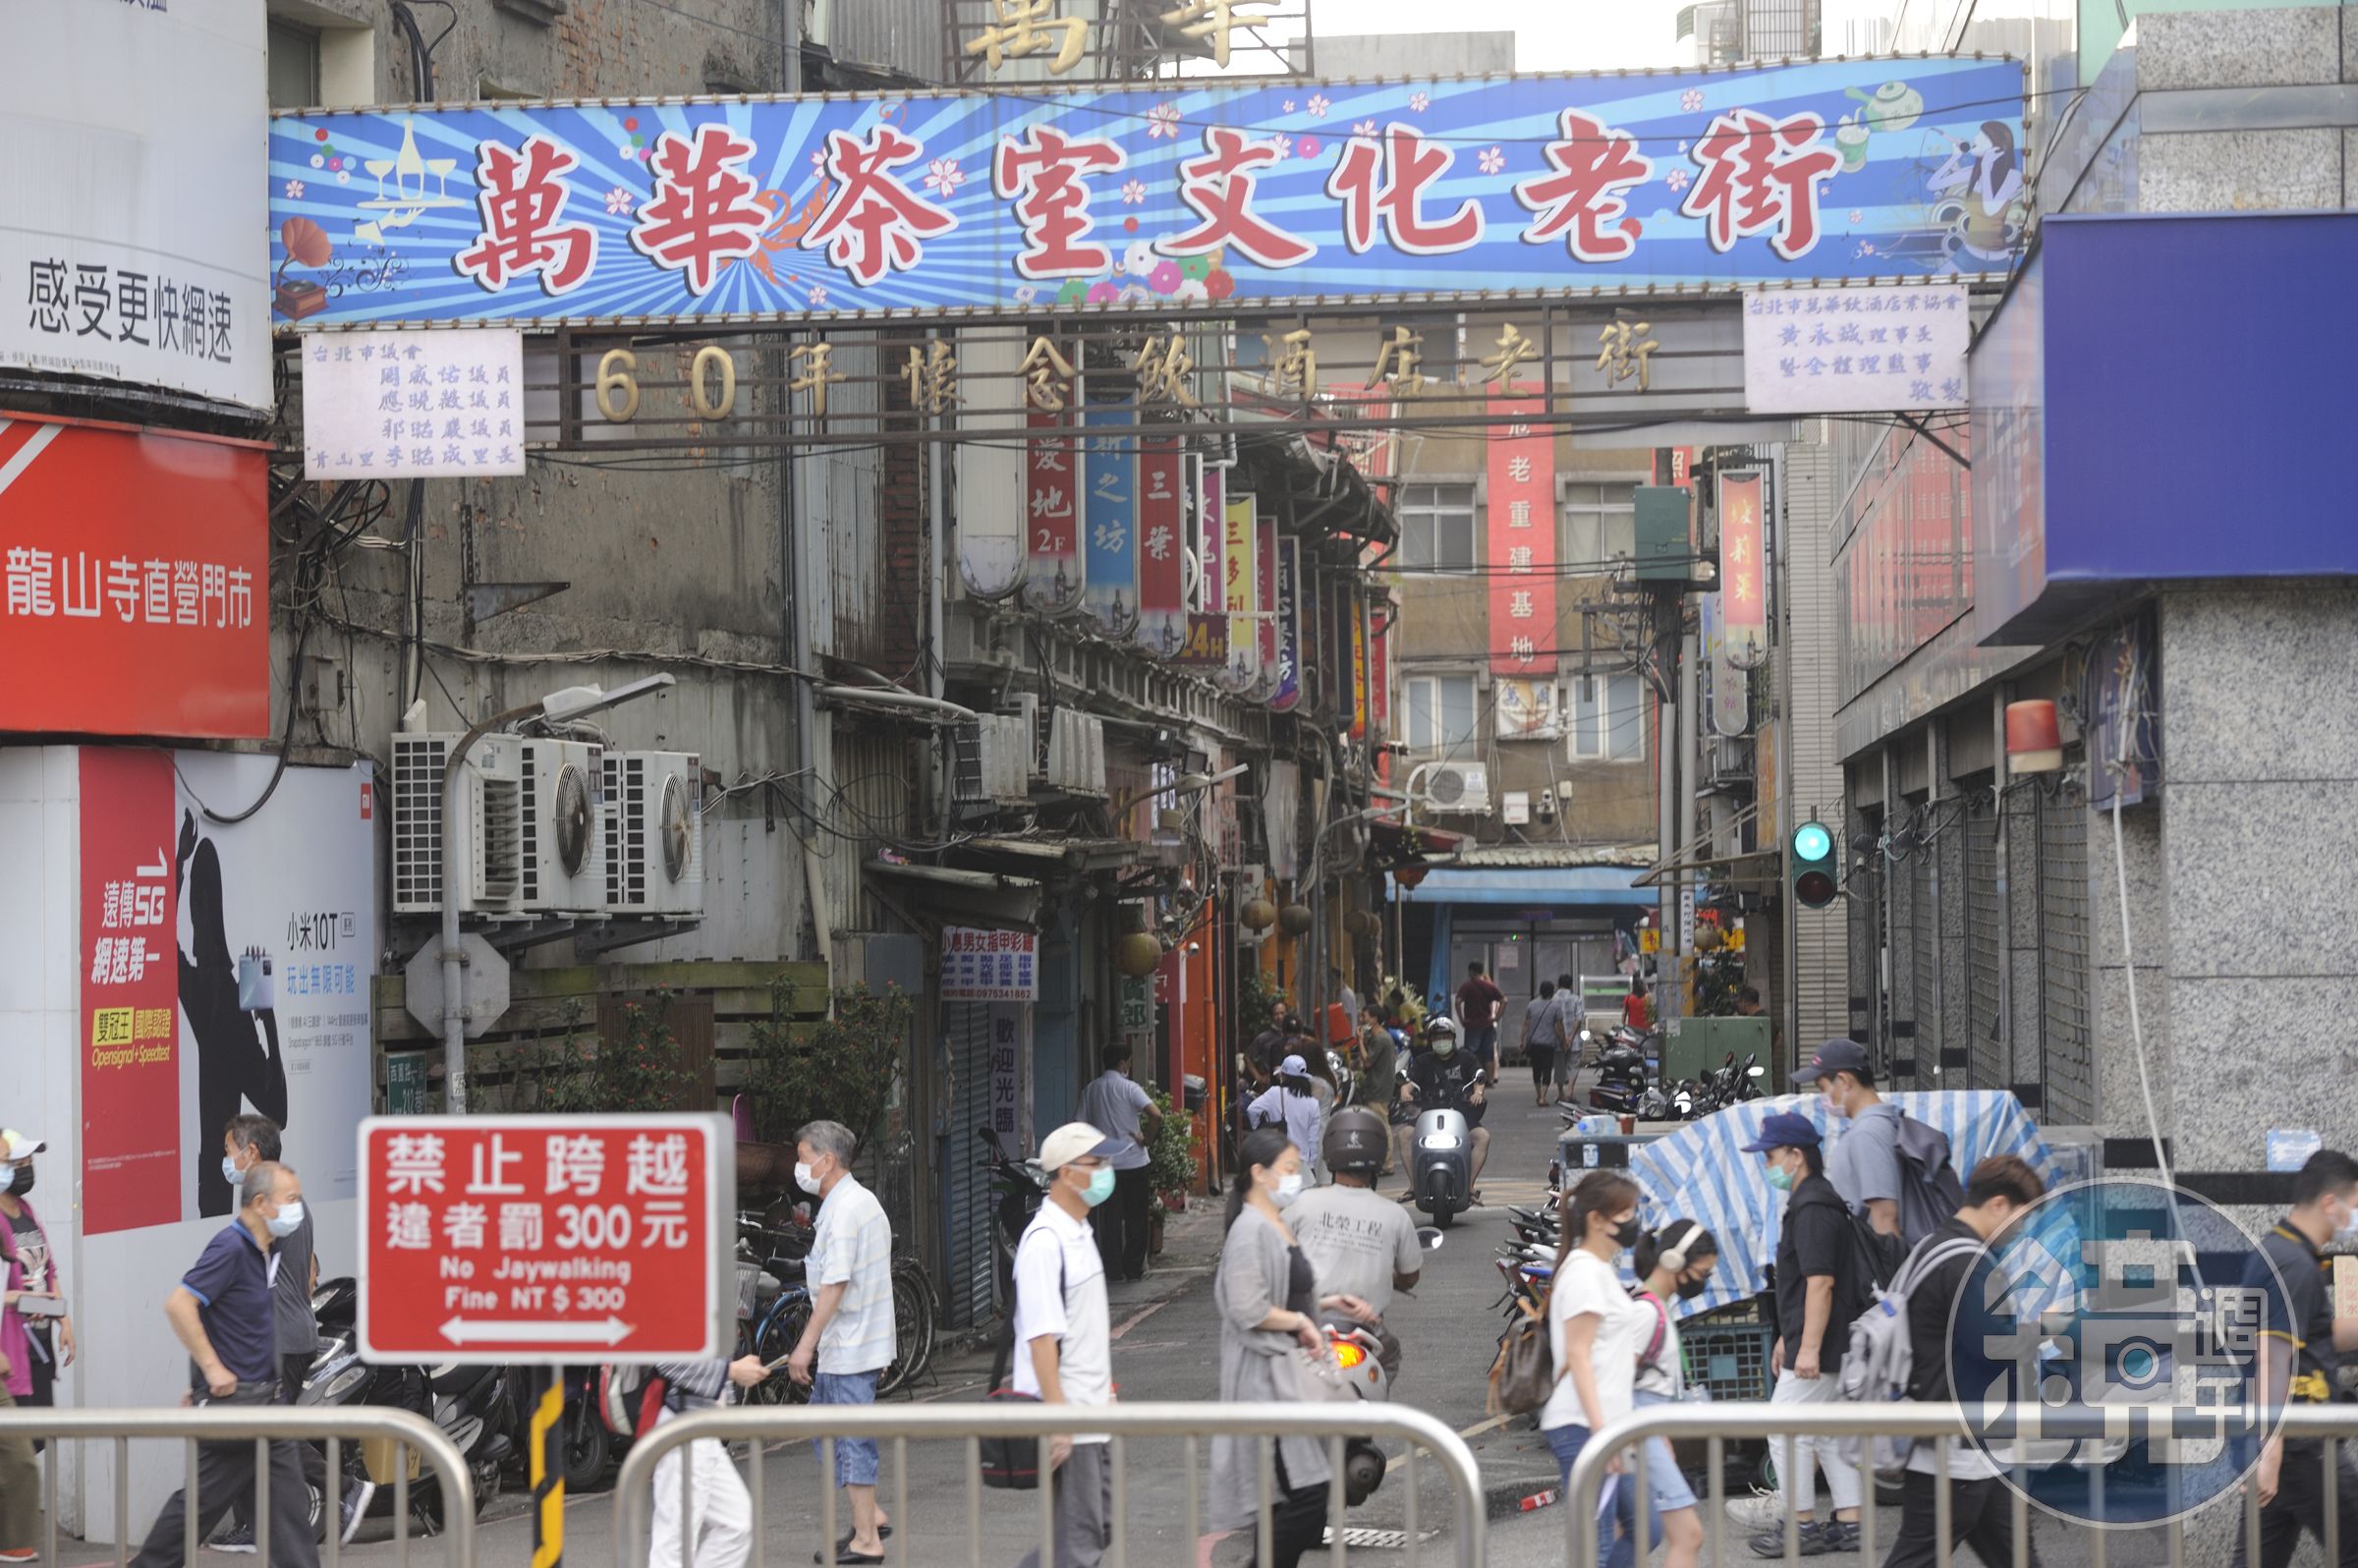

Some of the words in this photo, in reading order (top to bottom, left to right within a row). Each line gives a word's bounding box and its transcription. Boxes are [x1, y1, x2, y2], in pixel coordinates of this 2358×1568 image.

[453, 106, 1840, 297] 萬華茶室文化老街
[28, 255, 233, 364] 感受更快網速
[313, 342, 422, 363] 台北市議會
[1037, 529, 1066, 552] 2F
[6, 546, 253, 630] 龍山寺直營門市
[101, 879, 166, 928] 遠傳5G
[287, 912, 338, 951] 小米10T
[90, 936, 160, 984] 網速第一
[287, 963, 355, 994] 玩出無限可能
[96, 1011, 130, 1043] 雙冠王
[995, 1018, 1015, 1134] 歡迎光臨
[385, 1133, 690, 1197] 禁止跨越
[386, 1201, 689, 1251] 違者罰300元
[440, 1257, 475, 1278] No
[493, 1257, 632, 1286] Jaywalking
[446, 1286, 497, 1311] Fine
